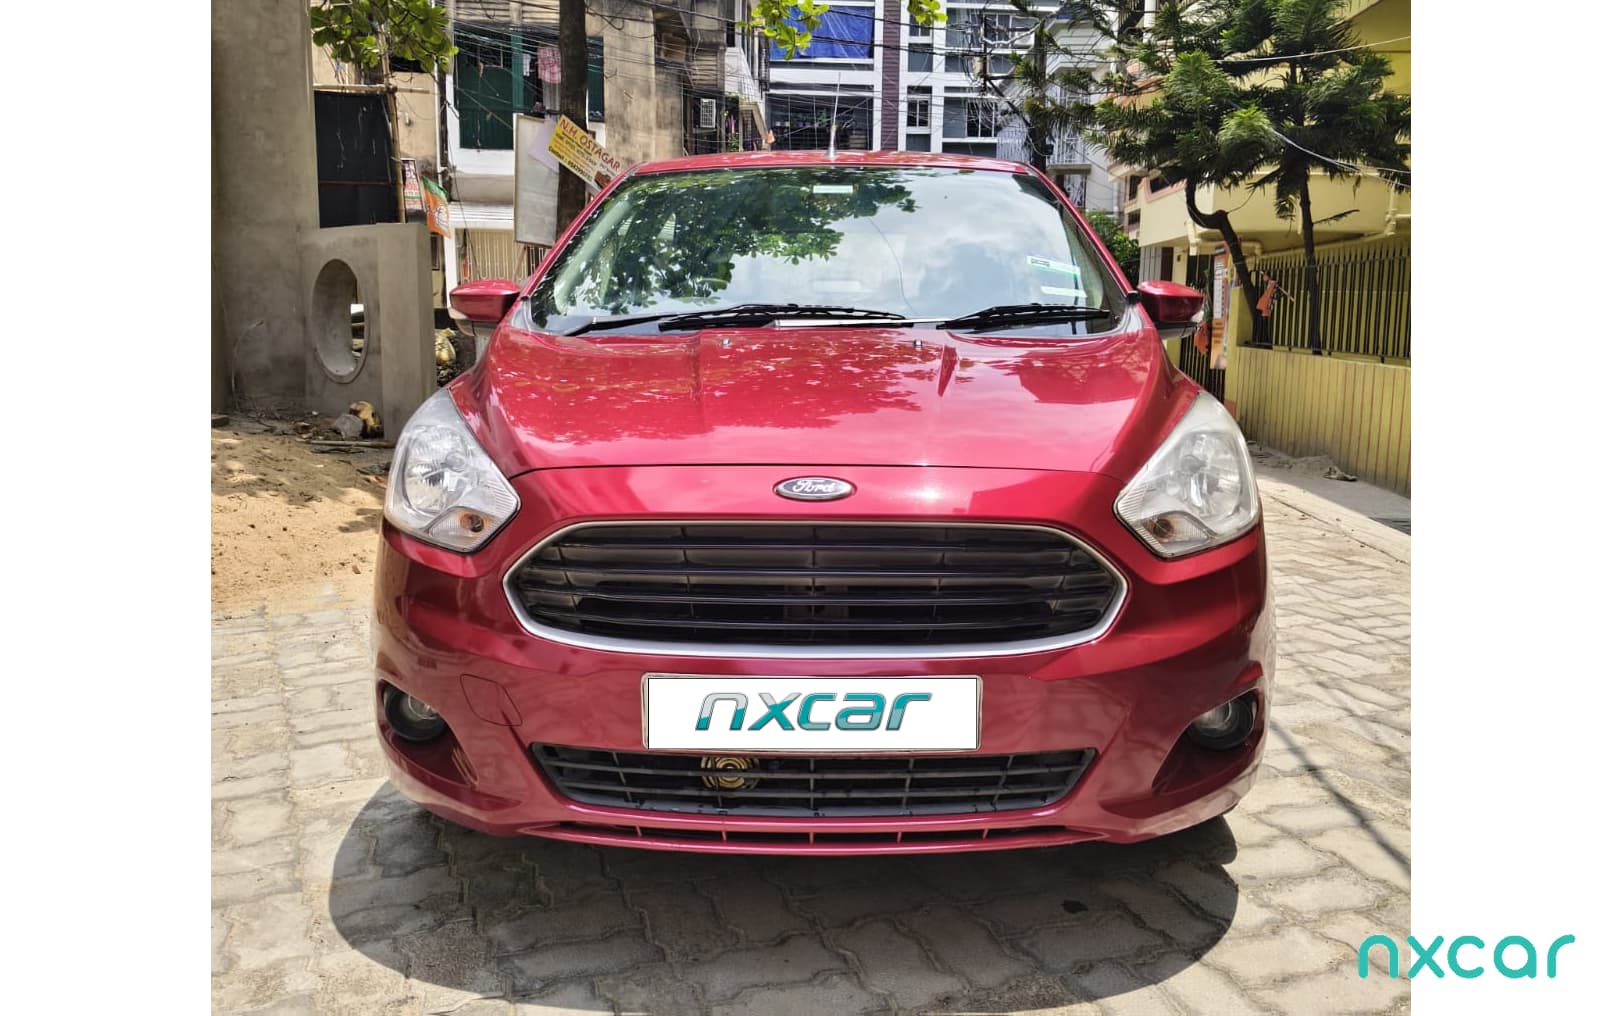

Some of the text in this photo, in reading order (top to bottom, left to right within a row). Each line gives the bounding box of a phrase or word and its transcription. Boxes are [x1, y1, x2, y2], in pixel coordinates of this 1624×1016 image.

[560, 118, 578, 140] N.H.
[579, 134, 621, 171] OSTAGAR
[791, 479, 836, 493] Ford
